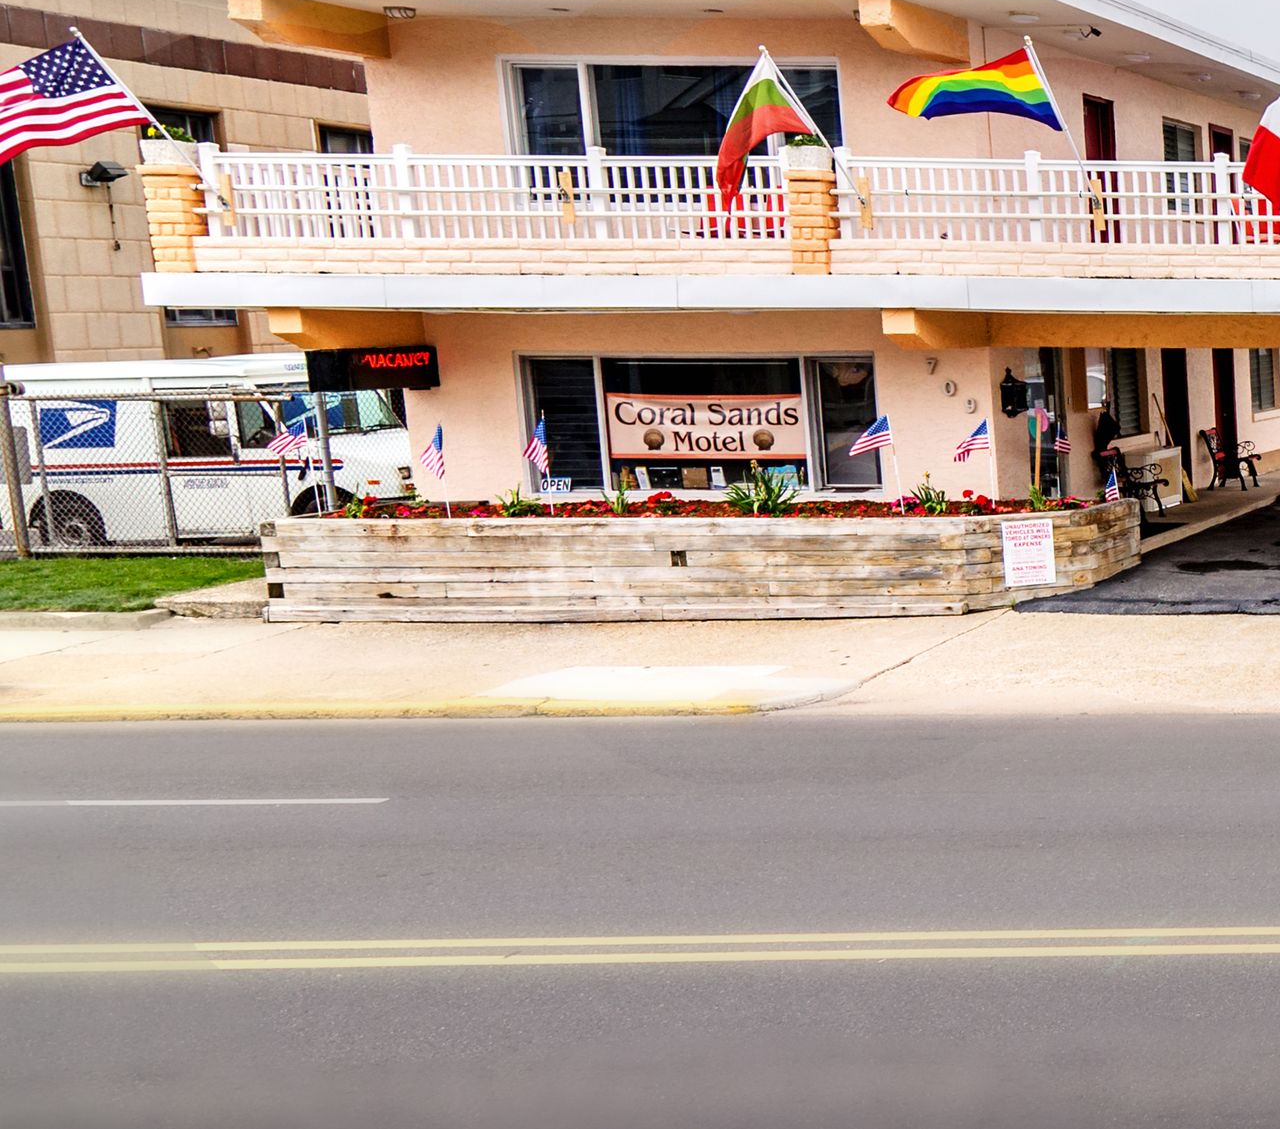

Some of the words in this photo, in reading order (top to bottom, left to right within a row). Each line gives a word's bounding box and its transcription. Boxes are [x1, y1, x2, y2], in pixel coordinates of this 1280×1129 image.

[366, 352, 430, 368] VACANCY
[614, 401, 696, 426] Coral
[708, 402, 799, 426] Sands
[673, 431, 746, 452] Motel
[542, 479, 569, 491] OPEN
